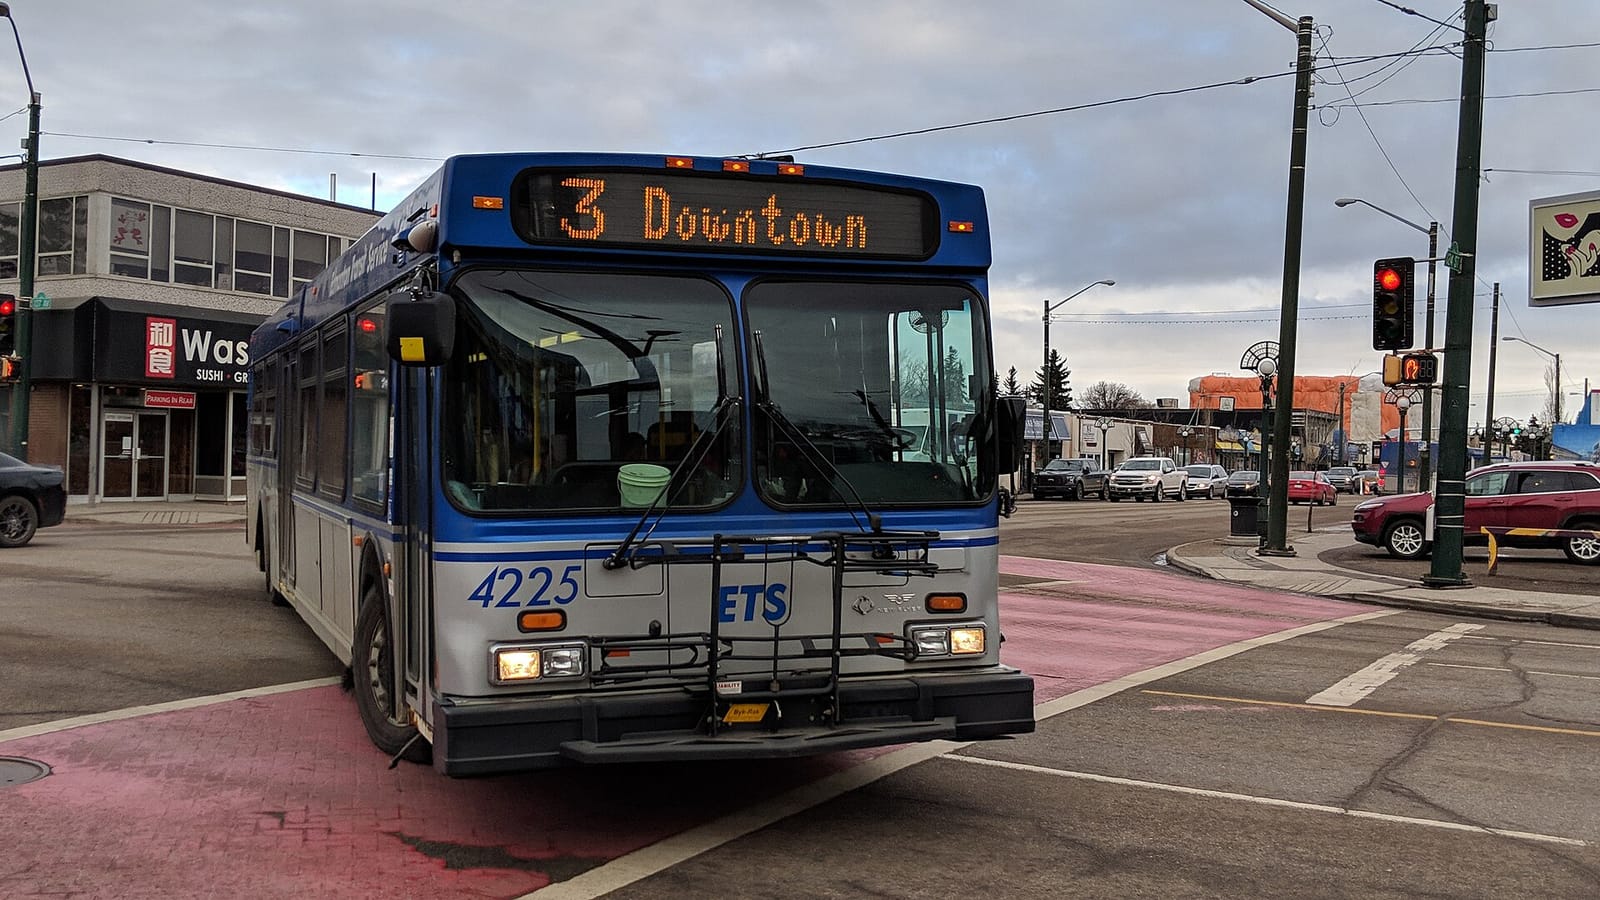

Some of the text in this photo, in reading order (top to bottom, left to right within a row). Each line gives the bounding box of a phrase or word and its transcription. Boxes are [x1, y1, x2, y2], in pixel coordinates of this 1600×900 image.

[561, 178, 867, 248] 3 Downtown
[366, 233, 388, 274] Service
[149, 322, 173, 374] 和食
[181, 328, 249, 366] Was
[196, 368, 224, 382] SUSHI
[467, 565, 582, 608] 4225
[718, 583, 787, 622] ETS
